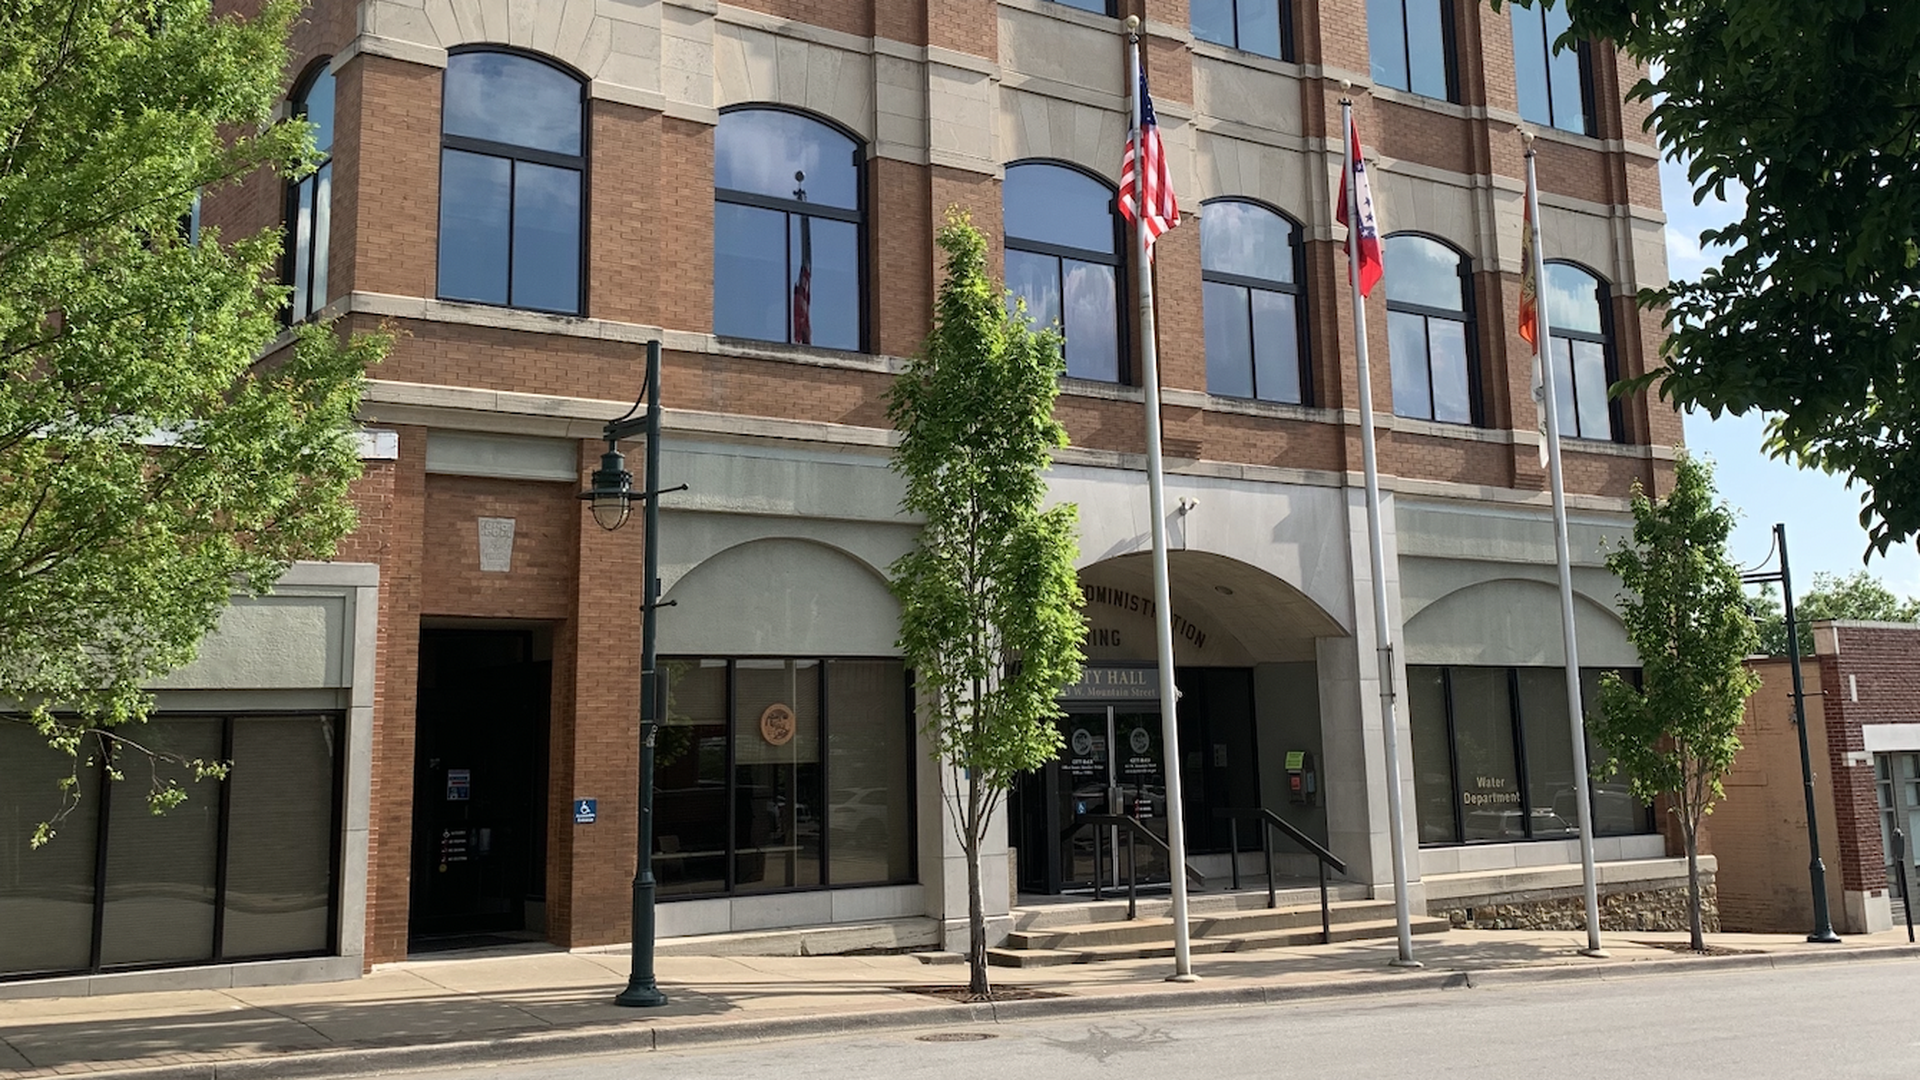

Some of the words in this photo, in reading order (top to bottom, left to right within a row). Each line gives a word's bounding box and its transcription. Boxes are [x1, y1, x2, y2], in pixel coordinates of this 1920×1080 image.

[1084, 584, 1206, 648] DMINISTTION
[1083, 669, 1102, 685] TY
[1107, 670, 1147, 685] HALL
[1087, 686, 1129, 697] Mountain
[1130, 687, 1156, 697] Street
[1476, 776, 1505, 788] Water
[1463, 791, 1520, 806] Department
